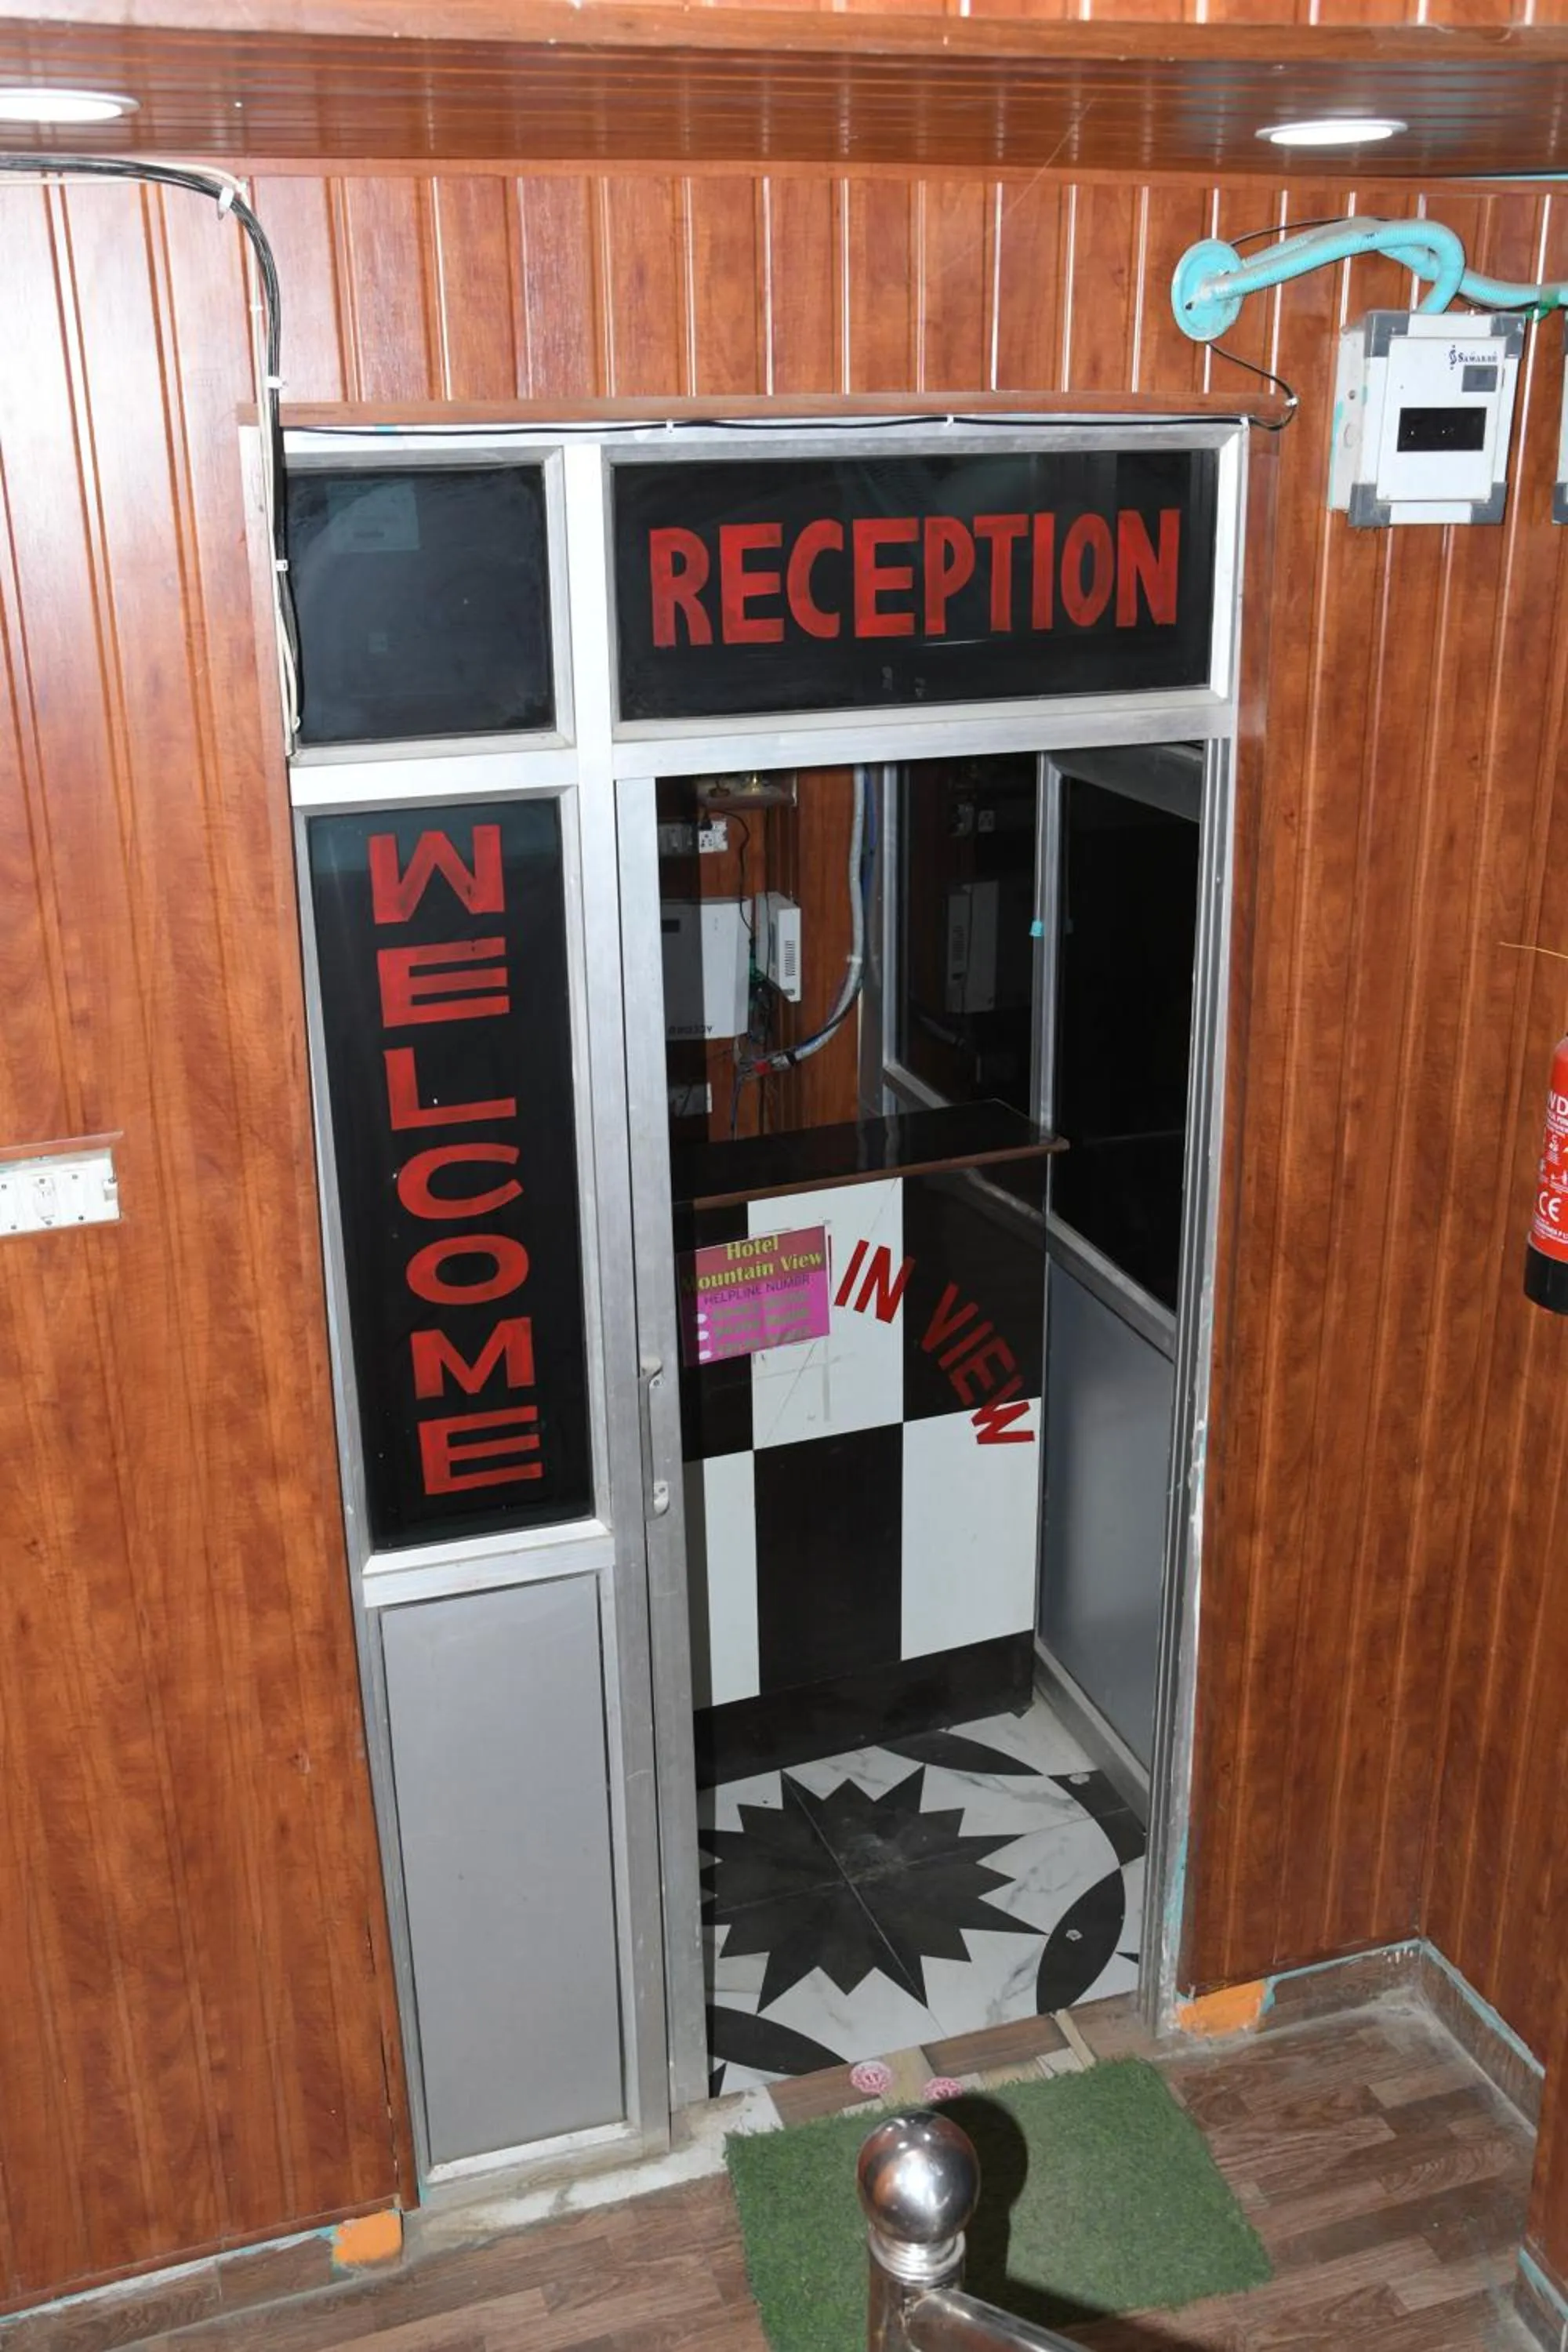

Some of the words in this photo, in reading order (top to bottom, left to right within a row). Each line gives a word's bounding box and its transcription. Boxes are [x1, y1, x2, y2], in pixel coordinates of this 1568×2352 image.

[649, 508, 1181, 648] RECEPTION
[367, 824, 543, 1495] WELCOME
[727, 1235, 779, 1261] Hotel
[780, 1252, 822, 1272] View
[833, 1240, 916, 1323] IN
[921, 1281, 1035, 1444] VIEW
